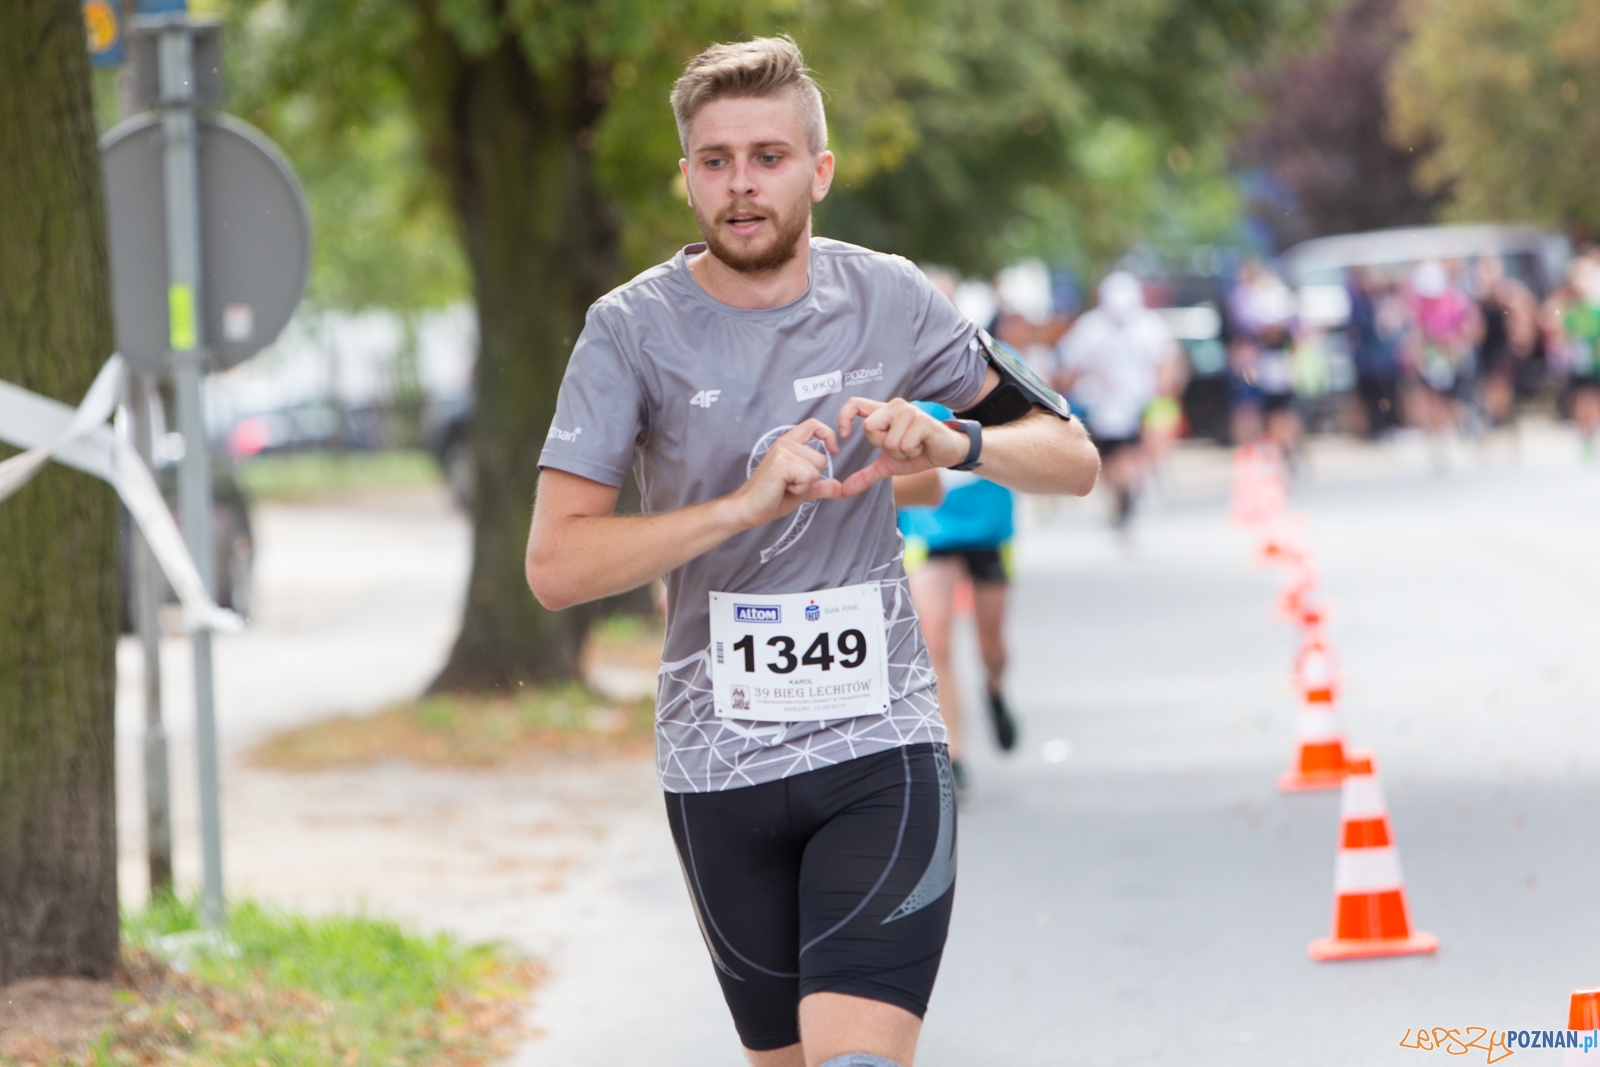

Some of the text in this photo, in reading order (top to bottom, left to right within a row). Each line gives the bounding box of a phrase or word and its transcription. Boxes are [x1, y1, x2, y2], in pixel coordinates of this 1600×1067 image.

[812, 378, 836, 391] PKO
[690, 389, 721, 408] 4F
[733, 629, 867, 674] 1349
[754, 688, 770, 699] 39
[774, 687, 805, 699] BIEG
[809, 679, 872, 698] LECHITÓW
